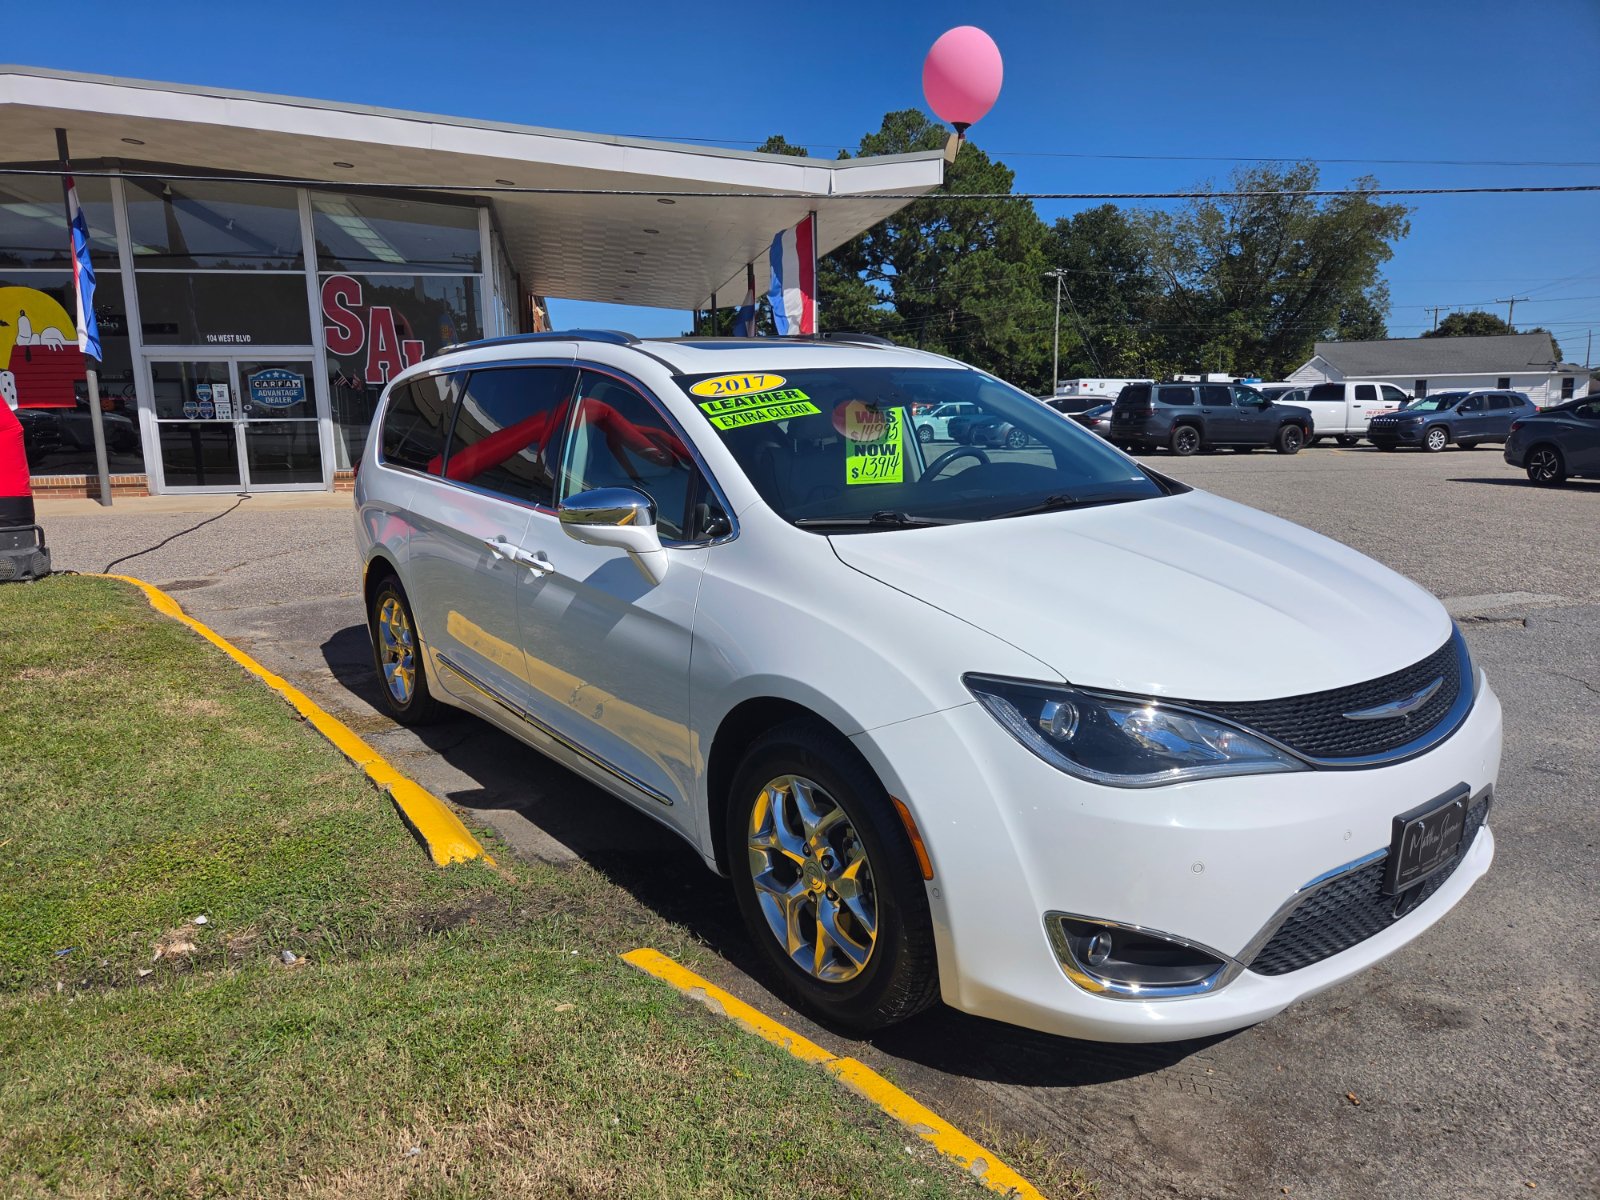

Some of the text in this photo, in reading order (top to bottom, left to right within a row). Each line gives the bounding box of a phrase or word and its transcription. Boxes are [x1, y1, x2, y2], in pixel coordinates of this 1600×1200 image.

[206, 334, 251, 342] 104 WEST BLVD
[254, 380, 300, 388] CARFAX
[710, 375, 765, 394] 2017
[258, 389, 298, 397] ADVANTAGE
[708, 390, 799, 412] LEATHER
[720, 403, 811, 426] EXTRA CLEAN
[855, 410, 897, 423] WAS
[854, 444, 897, 457] NOW
